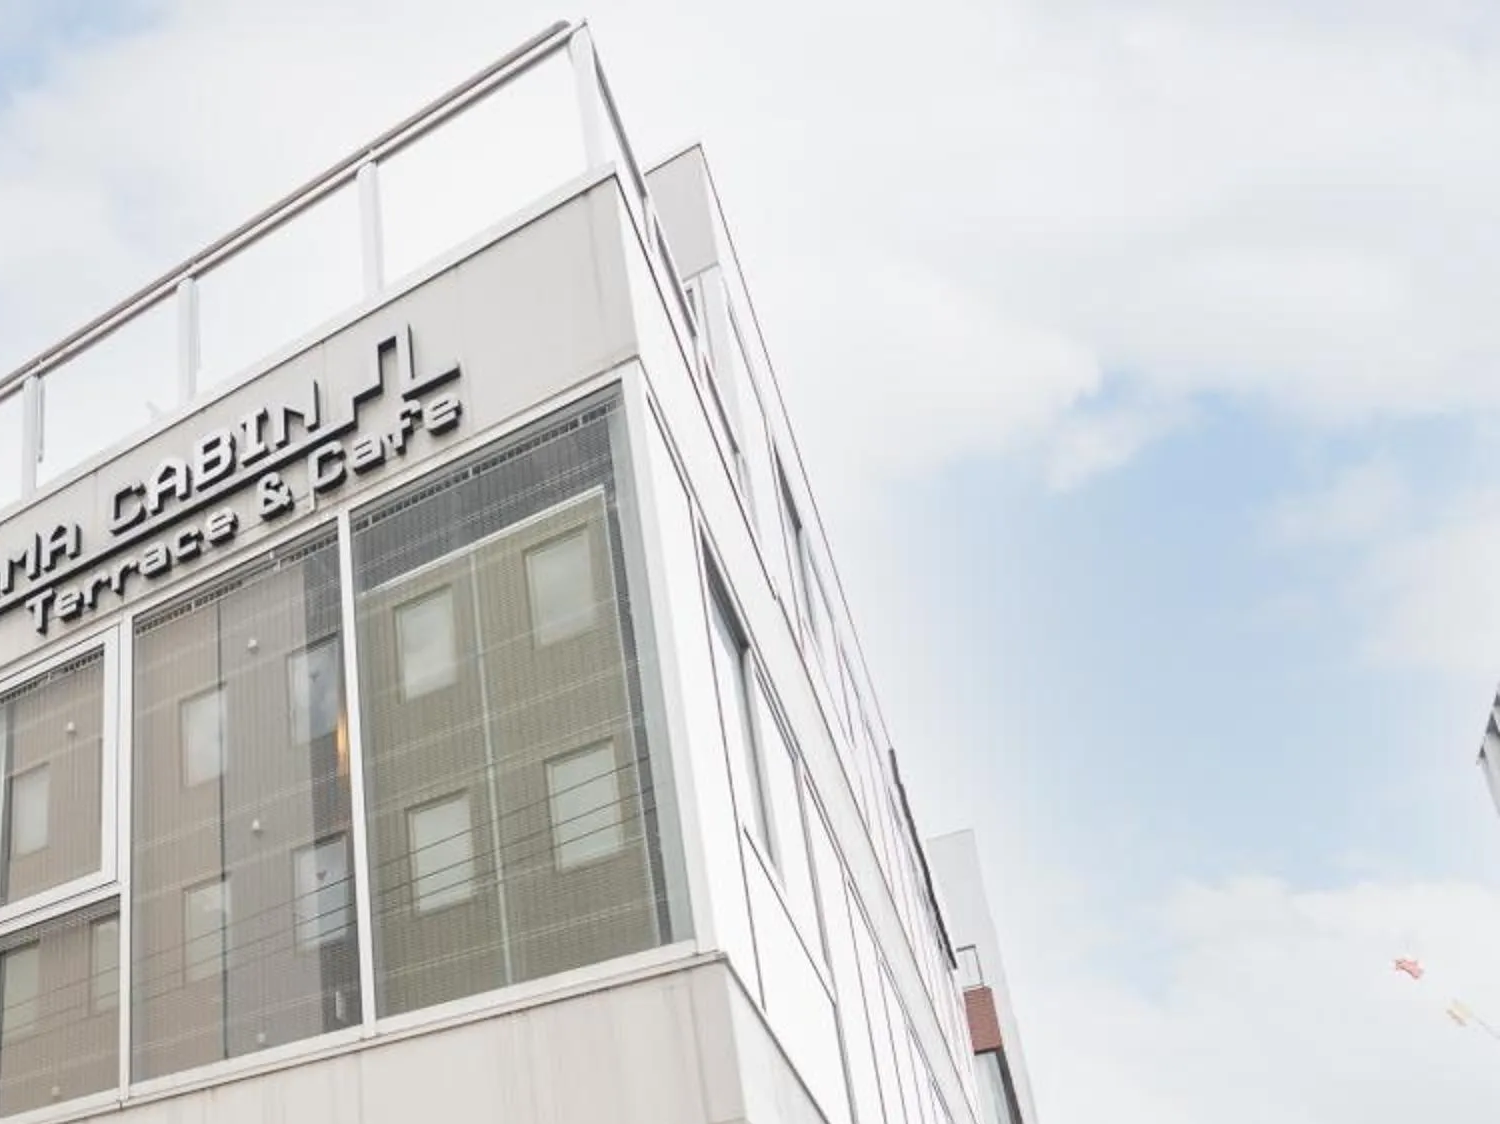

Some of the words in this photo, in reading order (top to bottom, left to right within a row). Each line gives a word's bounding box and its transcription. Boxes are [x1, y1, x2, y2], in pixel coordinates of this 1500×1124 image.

[26, 505, 239, 634] Terrace
[259, 472, 294, 520] &
[309, 392, 463, 499] Cafe
[109, 380, 320, 534] CABIN
